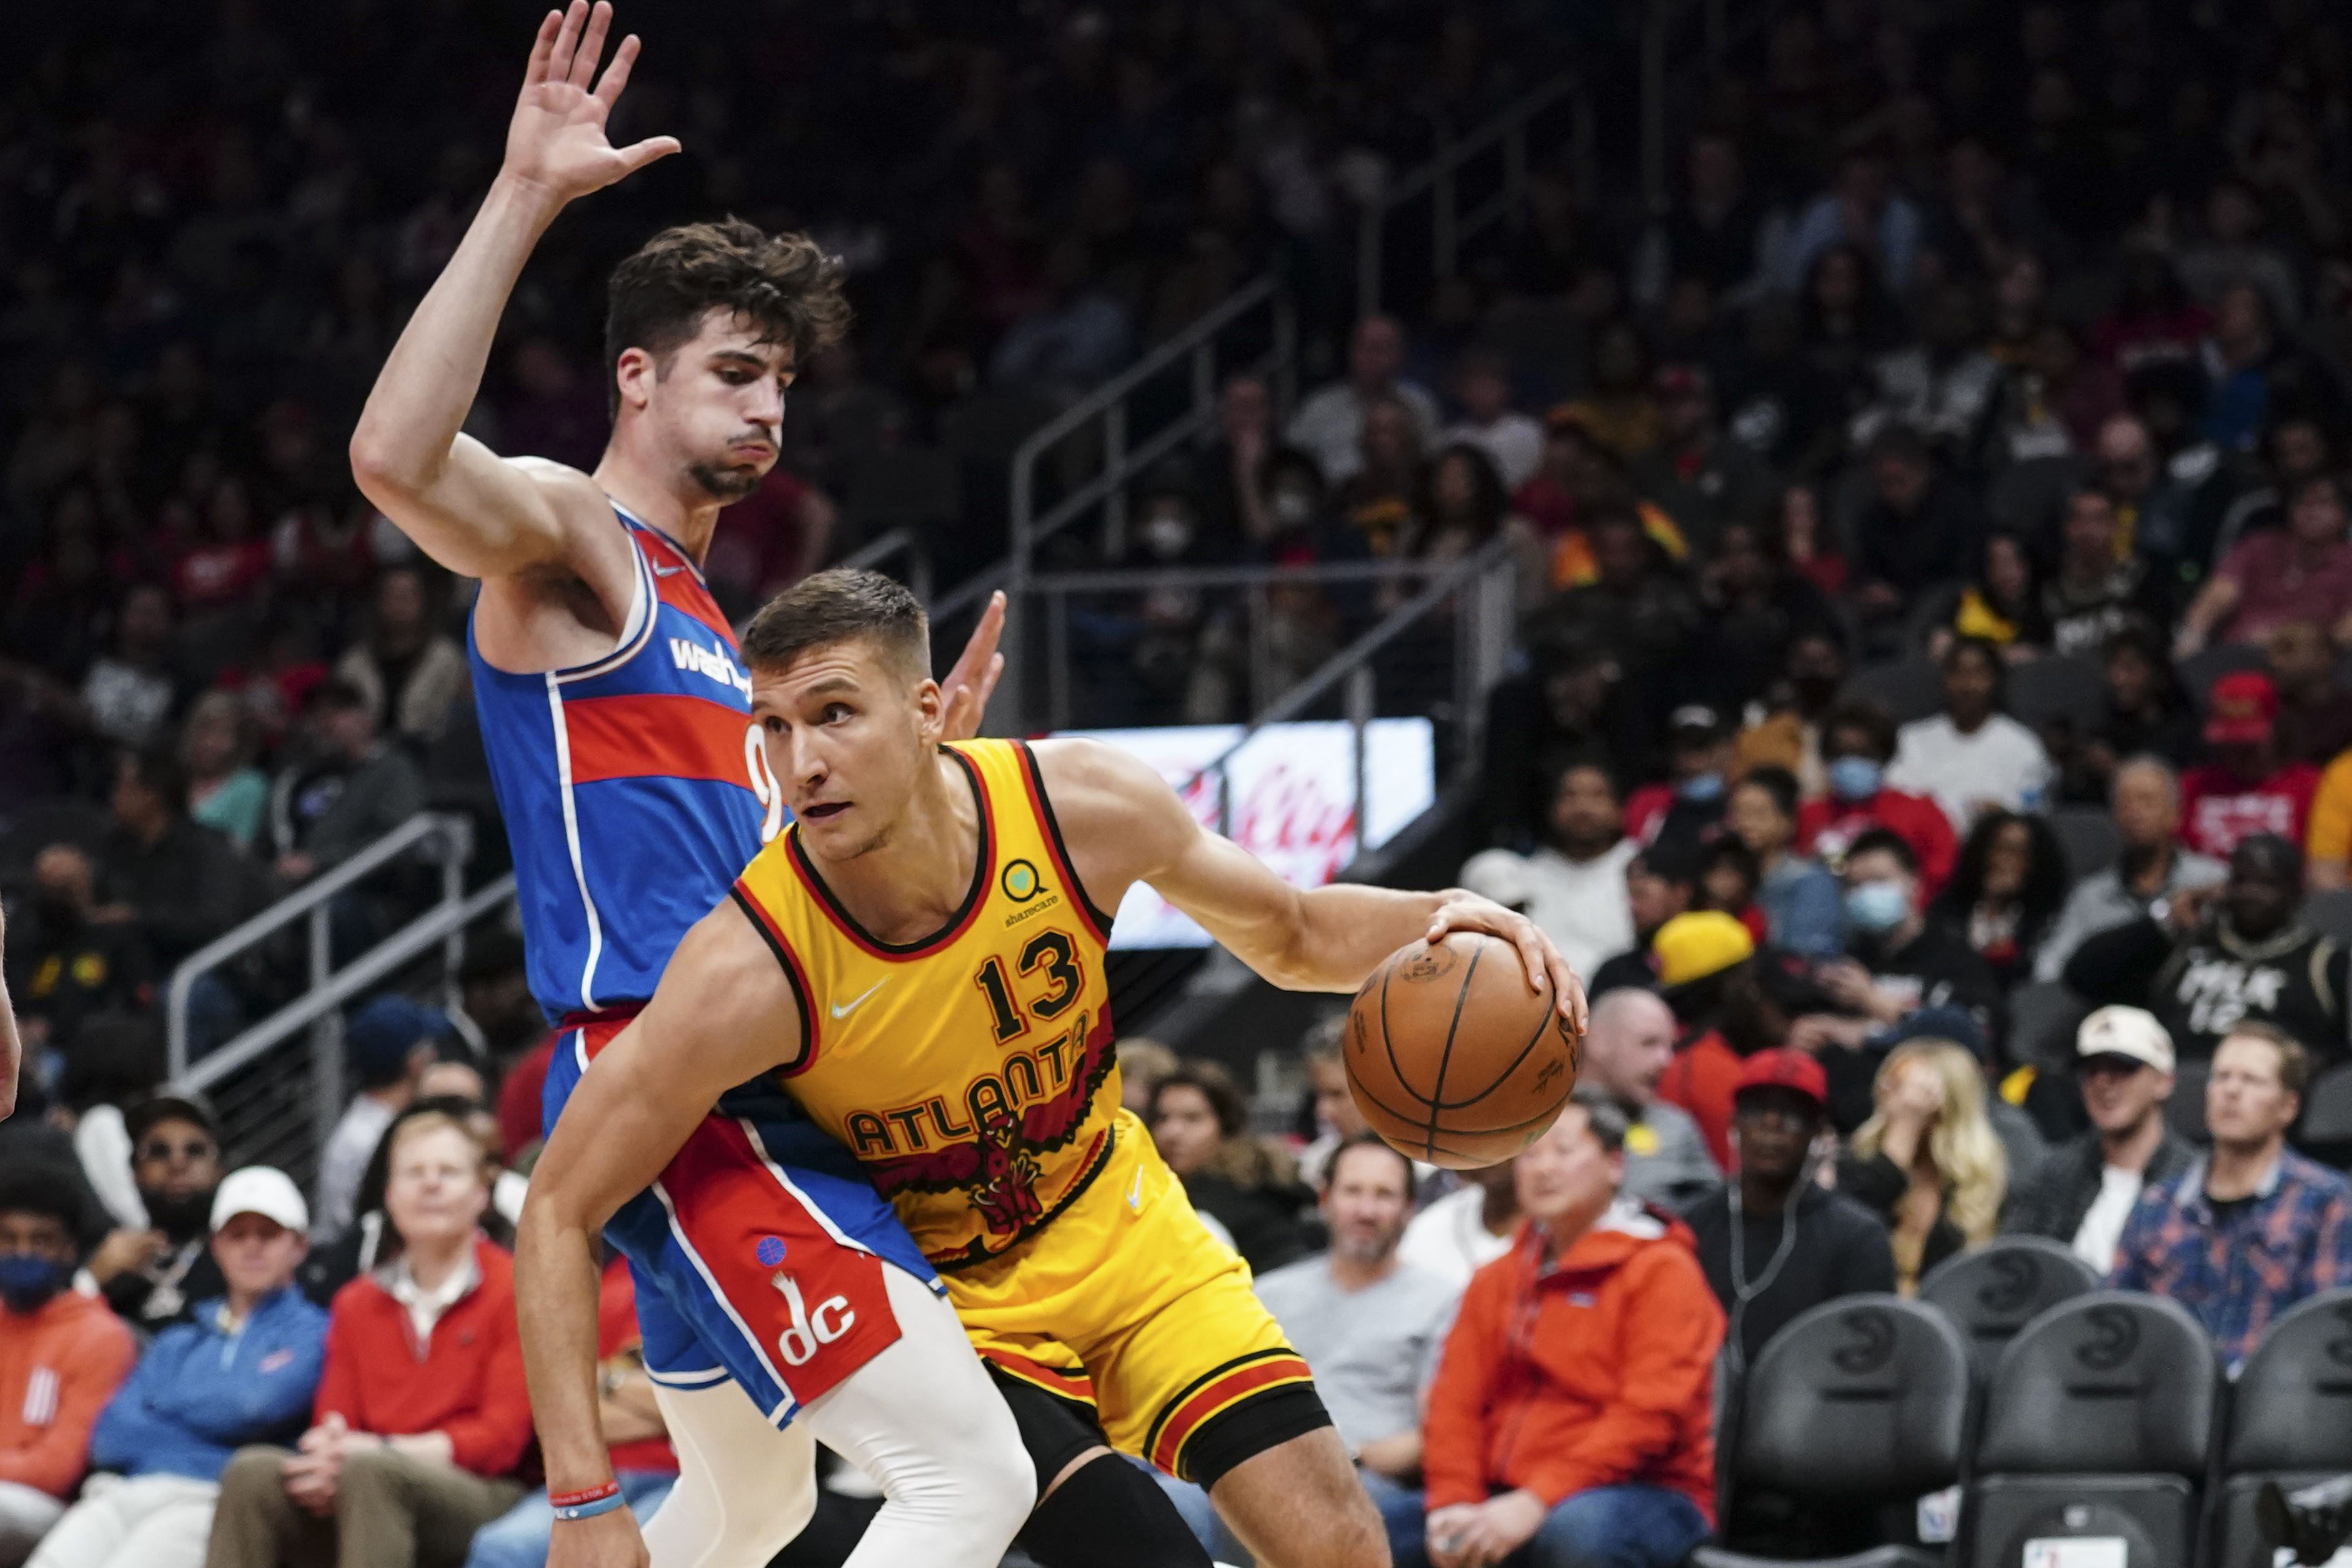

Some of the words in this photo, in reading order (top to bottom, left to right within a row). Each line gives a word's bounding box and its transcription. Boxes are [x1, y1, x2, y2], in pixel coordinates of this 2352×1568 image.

[1005, 895, 1058, 928] sharecare
[974, 927, 1085, 1045] 13
[845, 1010, 1089, 1159] ATLANTA
[773, 1270, 855, 1366] dc
